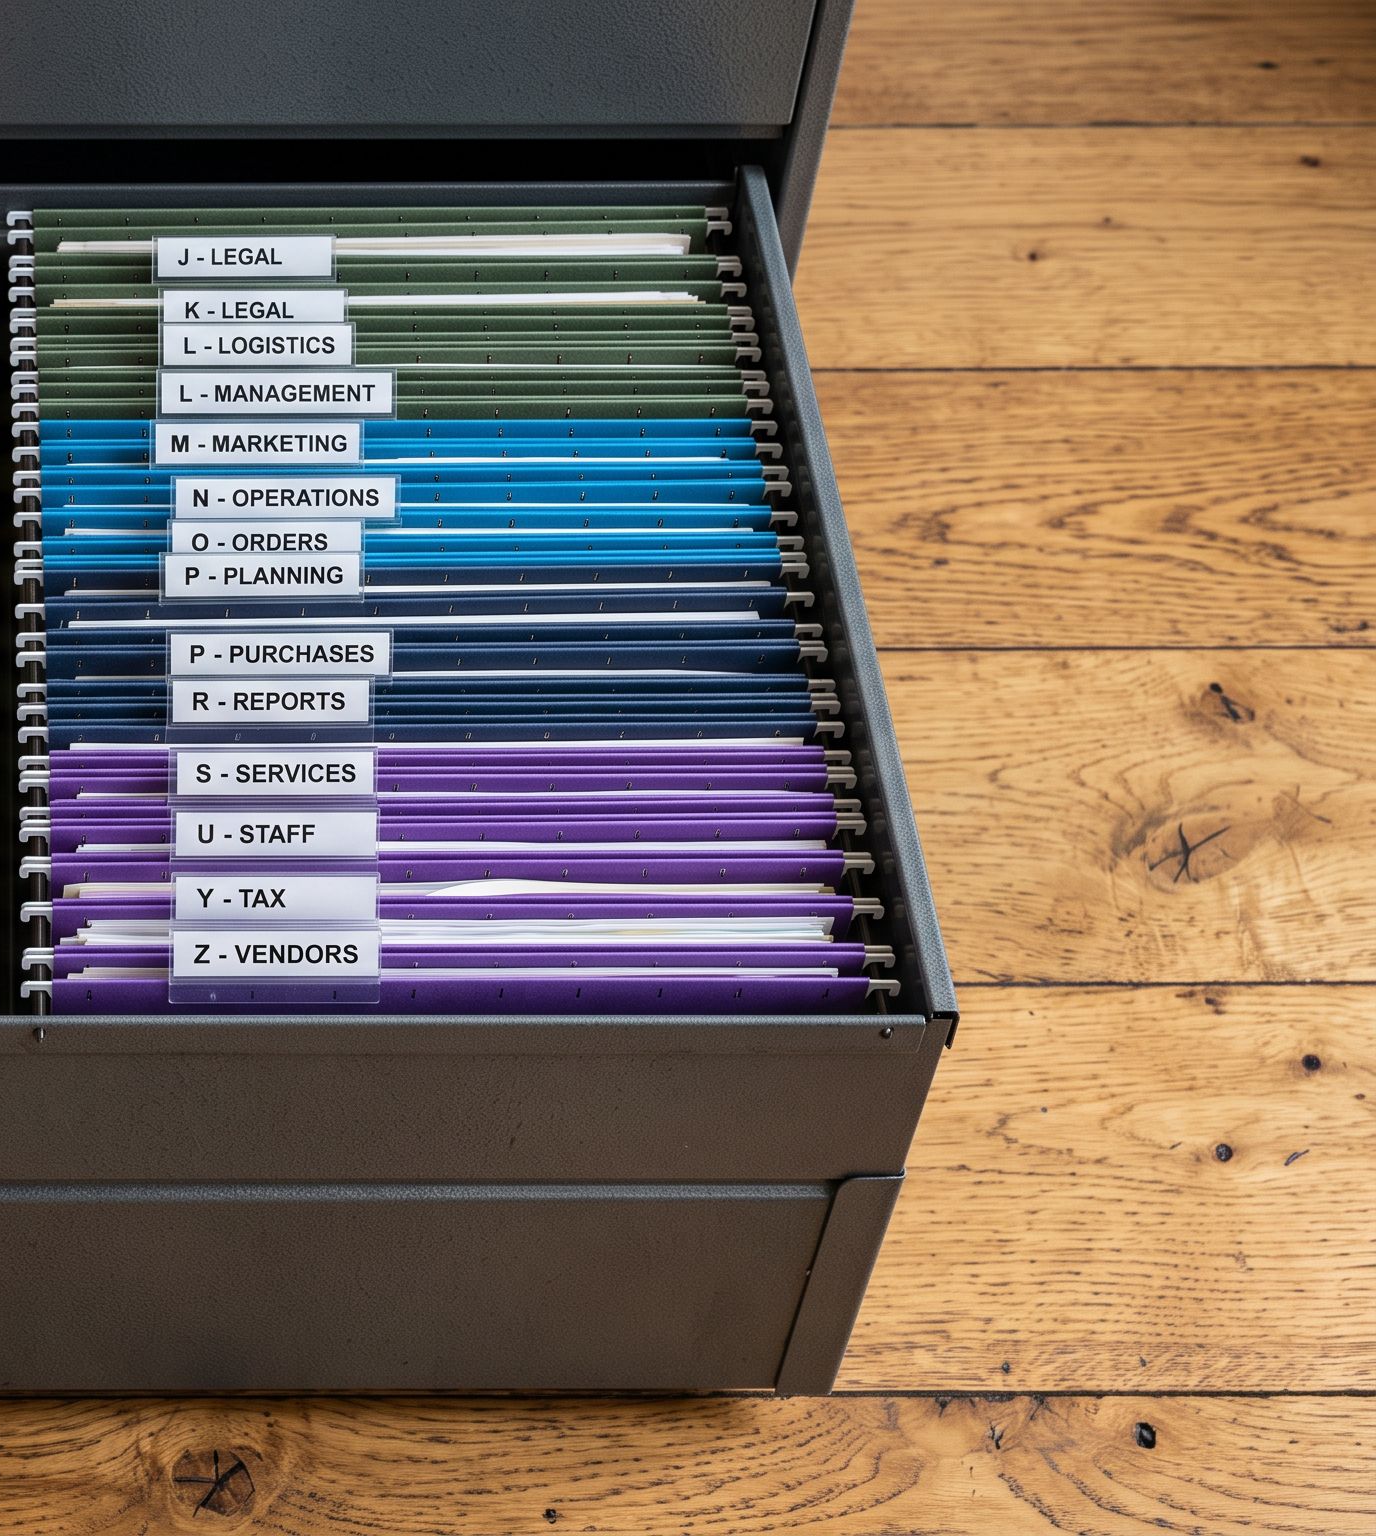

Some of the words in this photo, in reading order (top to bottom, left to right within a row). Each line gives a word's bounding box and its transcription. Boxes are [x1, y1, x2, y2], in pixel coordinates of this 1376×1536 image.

[177, 248, 189, 266] J
[211, 247, 283, 266] LEGAL
[185, 301, 200, 319] K
[222, 301, 295, 319] LEGAL
[184, 336, 197, 355] L
[218, 336, 335, 355] LOGISTICS
[179, 384, 193, 403] L
[214, 384, 376, 403] MANAGEMENT
[171, 434, 190, 453] M
[212, 434, 347, 453] MARKETING
[193, 488, 209, 508] N
[232, 488, 380, 508] OPERATIONS
[191, 532, 209, 552] O
[232, 532, 328, 552] ORDERS
[185, 566, 200, 586] P
[223, 565, 344, 586] PLANNING
[190, 644, 205, 664] P
[229, 644, 375, 664] PURCHASES
[192, 691, 210, 711] R
[233, 691, 346, 711] REPORTS
[195, 763, 212, 784] S
[235, 763, 356, 784] SERVICES
[198, 823, 214, 844] U
[239, 824, 316, 844] STAFF
[196, 888, 215, 908] Y
[238, 888, 286, 909] TAX
[193, 944, 211, 964] Z
[234, 944, 359, 964] VENDORS
